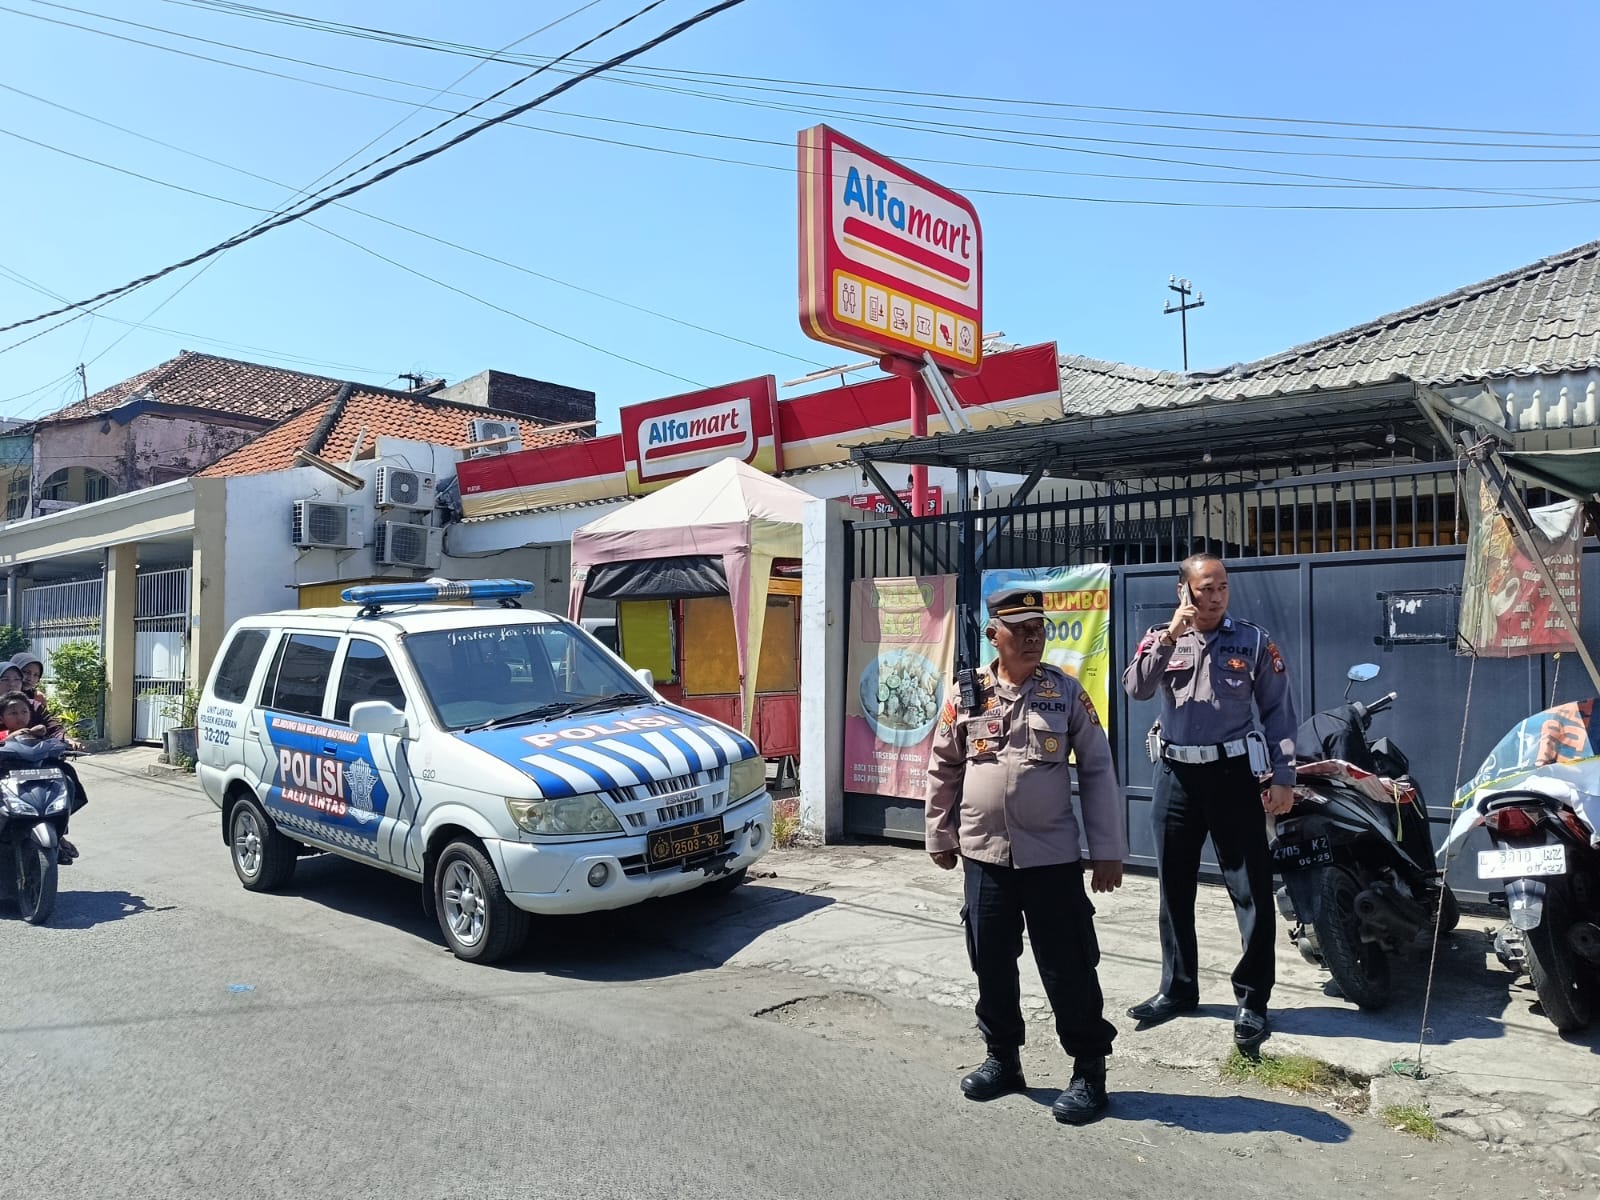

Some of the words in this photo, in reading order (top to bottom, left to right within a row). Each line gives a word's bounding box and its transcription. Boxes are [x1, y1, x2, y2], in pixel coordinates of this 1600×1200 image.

[843, 166, 971, 259] Alfamart
[648, 408, 740, 445] Alfamart
[1043, 590, 1106, 610] JUMBO
[447, 630, 496, 646] Justice
[498, 627, 518, 642] for
[1219, 645, 1253, 657] POLRI
[1030, 701, 1066, 713] POLRI
[204, 726, 230, 746] 32-202
[522, 714, 681, 748] POLISI
[279, 748, 344, 798] POLISI
[281, 787, 307, 803] LALU
[308, 793, 347, 816] LINTAS
[665, 791, 698, 805] ISUZU
[692, 826, 700, 836] X
